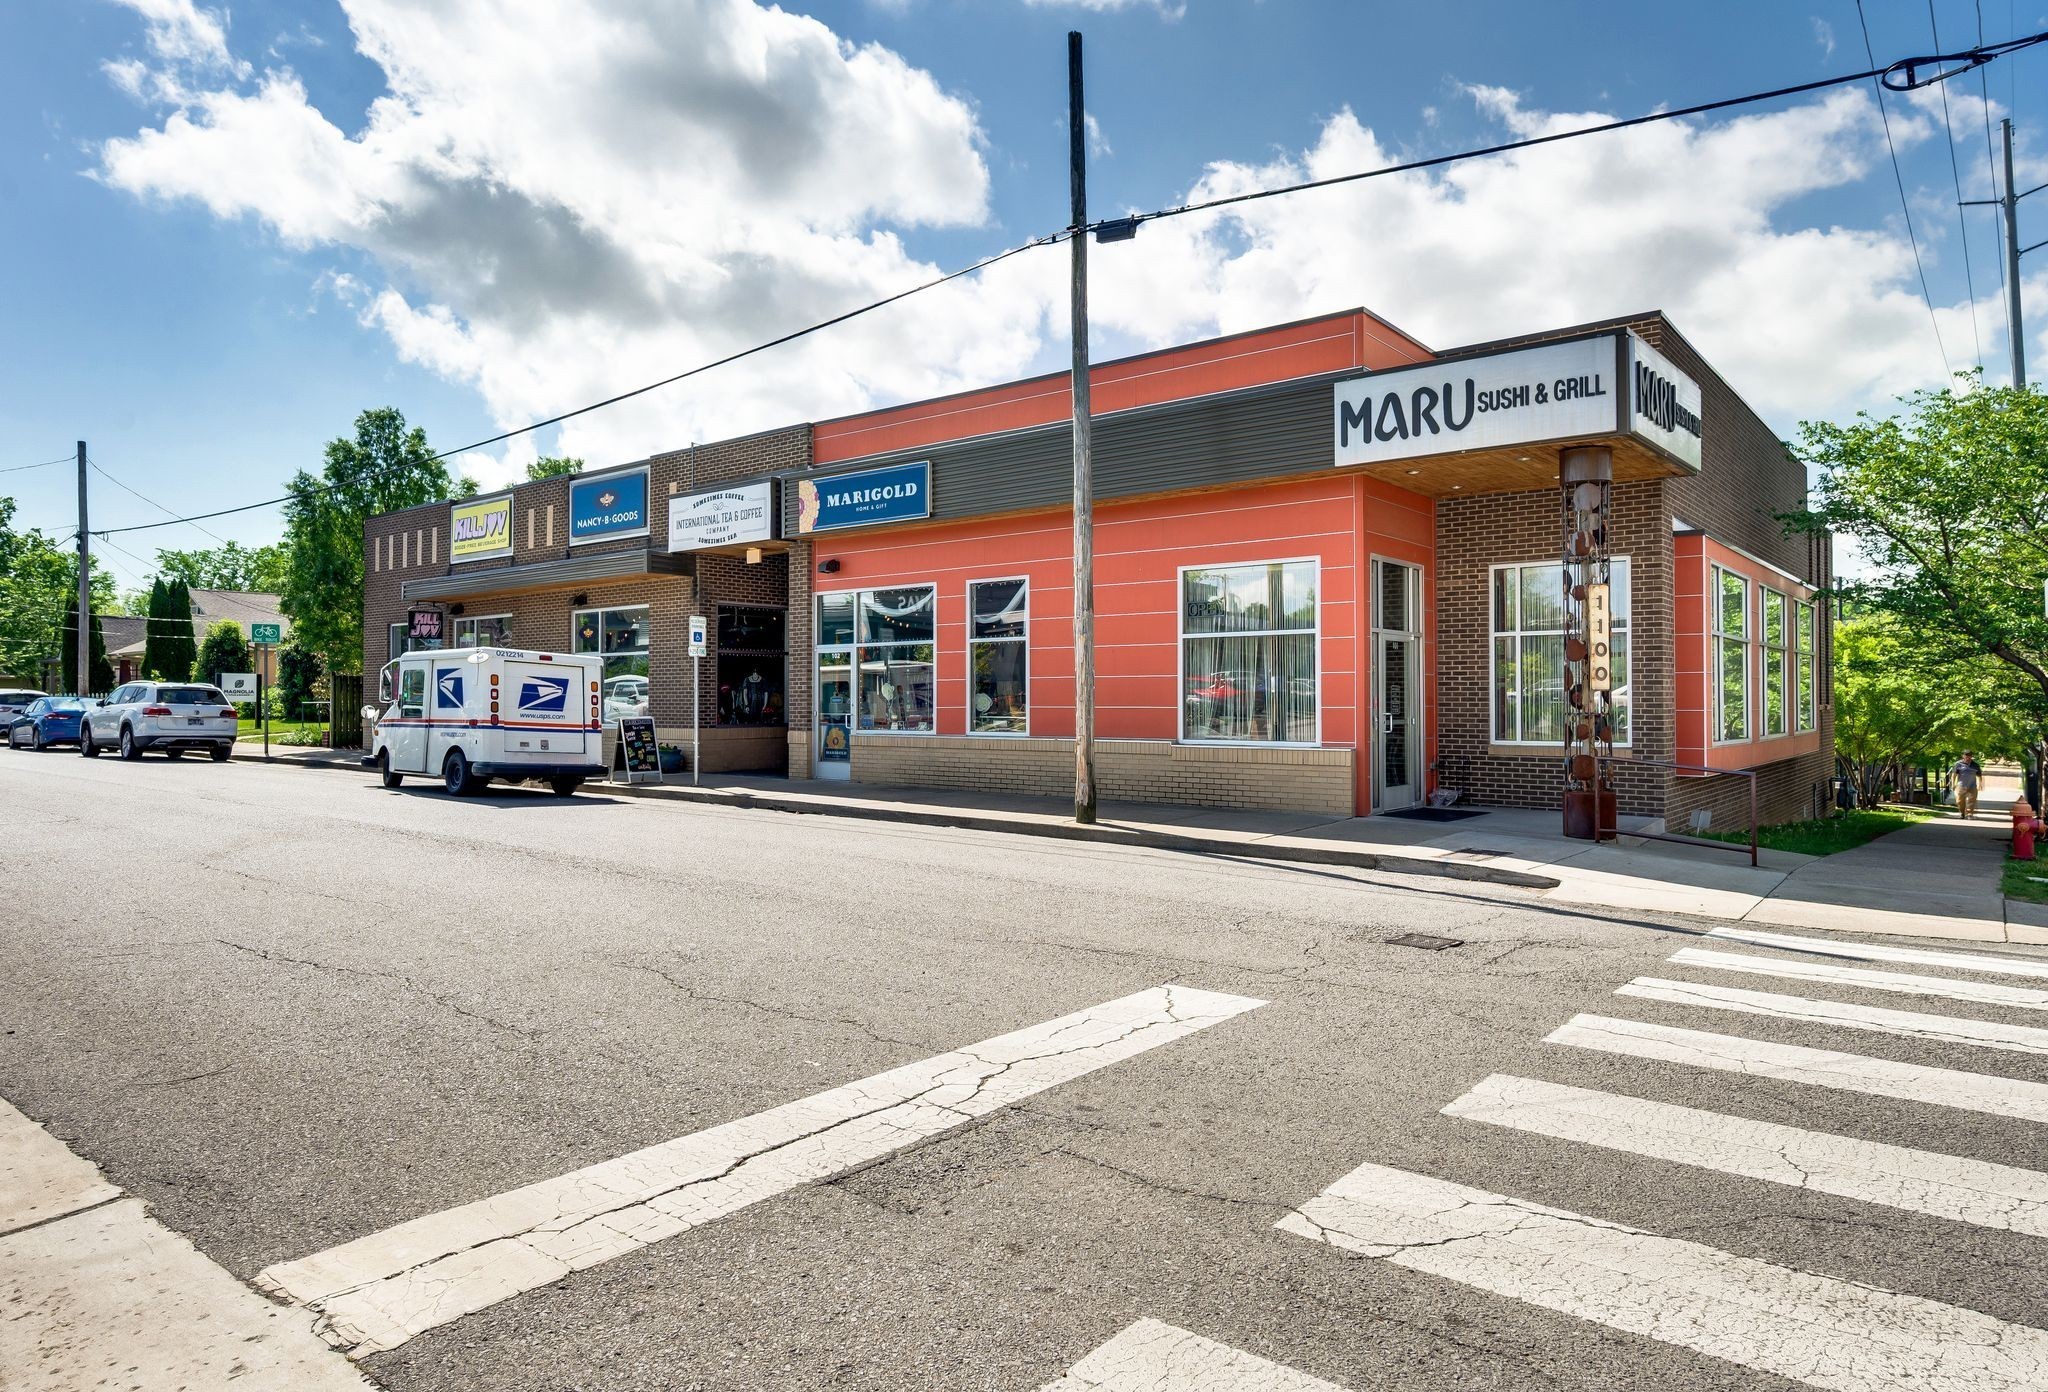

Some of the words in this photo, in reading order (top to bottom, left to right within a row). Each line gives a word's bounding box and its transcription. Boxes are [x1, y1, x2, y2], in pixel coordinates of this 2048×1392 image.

[1635, 361, 1676, 432] MARU
[1340, 378, 1475, 448] MARU
[1477, 385, 1530, 413] SUSHI
[1535, 383, 1548, 405] &
[1553, 374, 1606, 401] GRILL
[725, 493, 745, 502] COFFEE
[827, 483, 918, 507] MARIGOLD
[676, 514, 720, 530] INTERNATIONAL
[721, 512, 732, 523] TEA
[734, 511, 739, 521] &
[740, 507, 763, 521] COFFEE
[706, 526, 730, 534] COMPANY
[414, 612, 440, 625] KILL
[1595, 595, 1608, 681] 1100
[496, 650, 524, 658] 0212214
